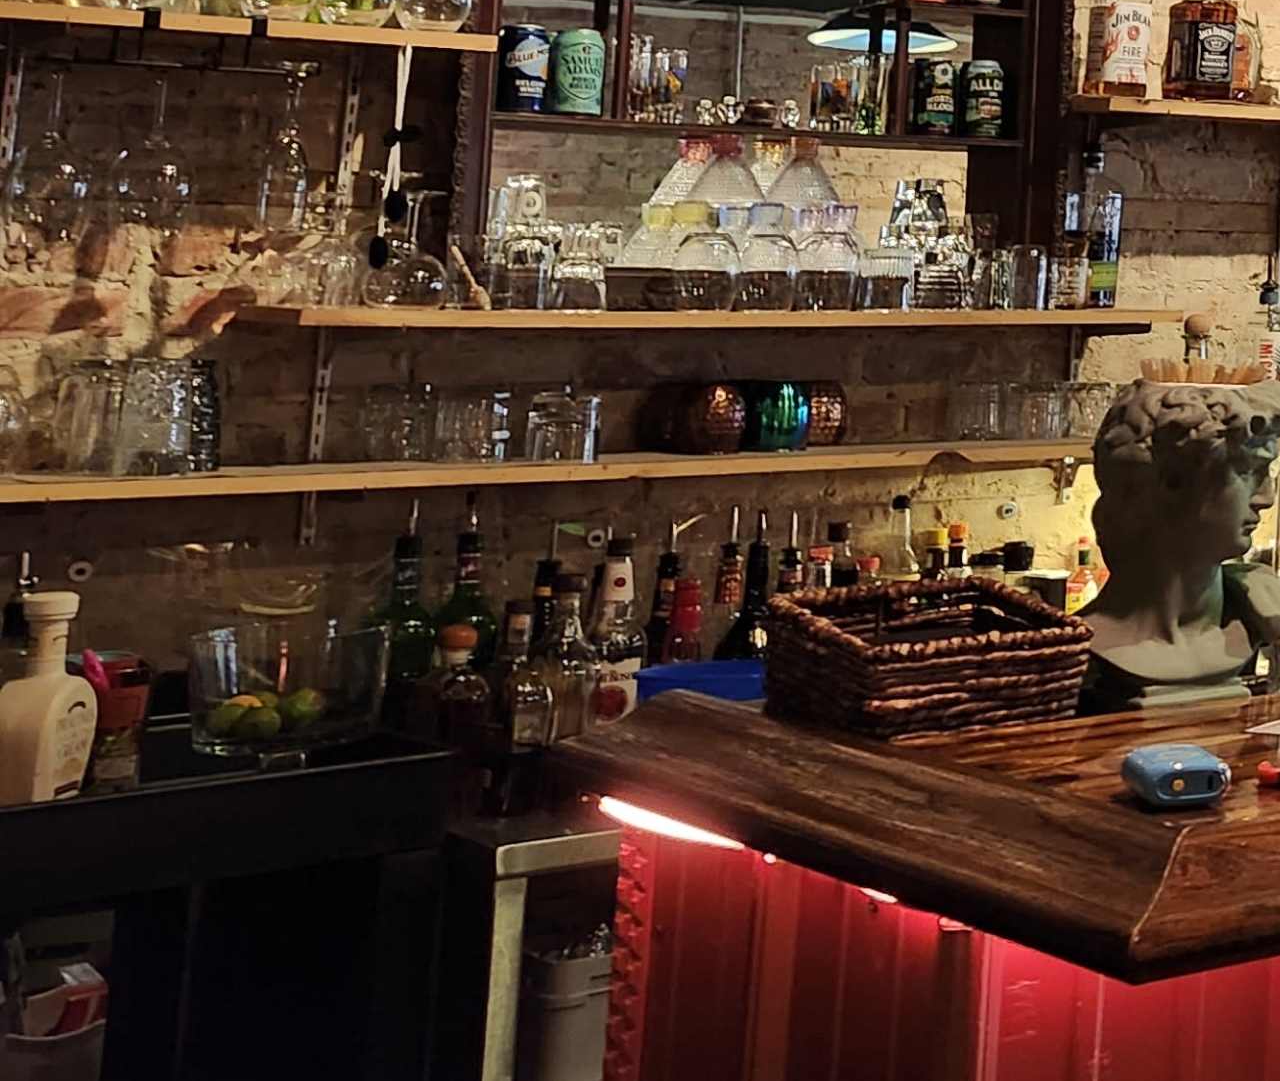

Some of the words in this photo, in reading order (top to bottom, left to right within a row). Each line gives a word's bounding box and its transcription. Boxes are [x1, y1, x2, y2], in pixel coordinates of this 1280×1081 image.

[1111, 12, 1131, 28] JIM
[1122, 45, 1142, 58] FIRE
[969, 79, 992, 91] ALL
